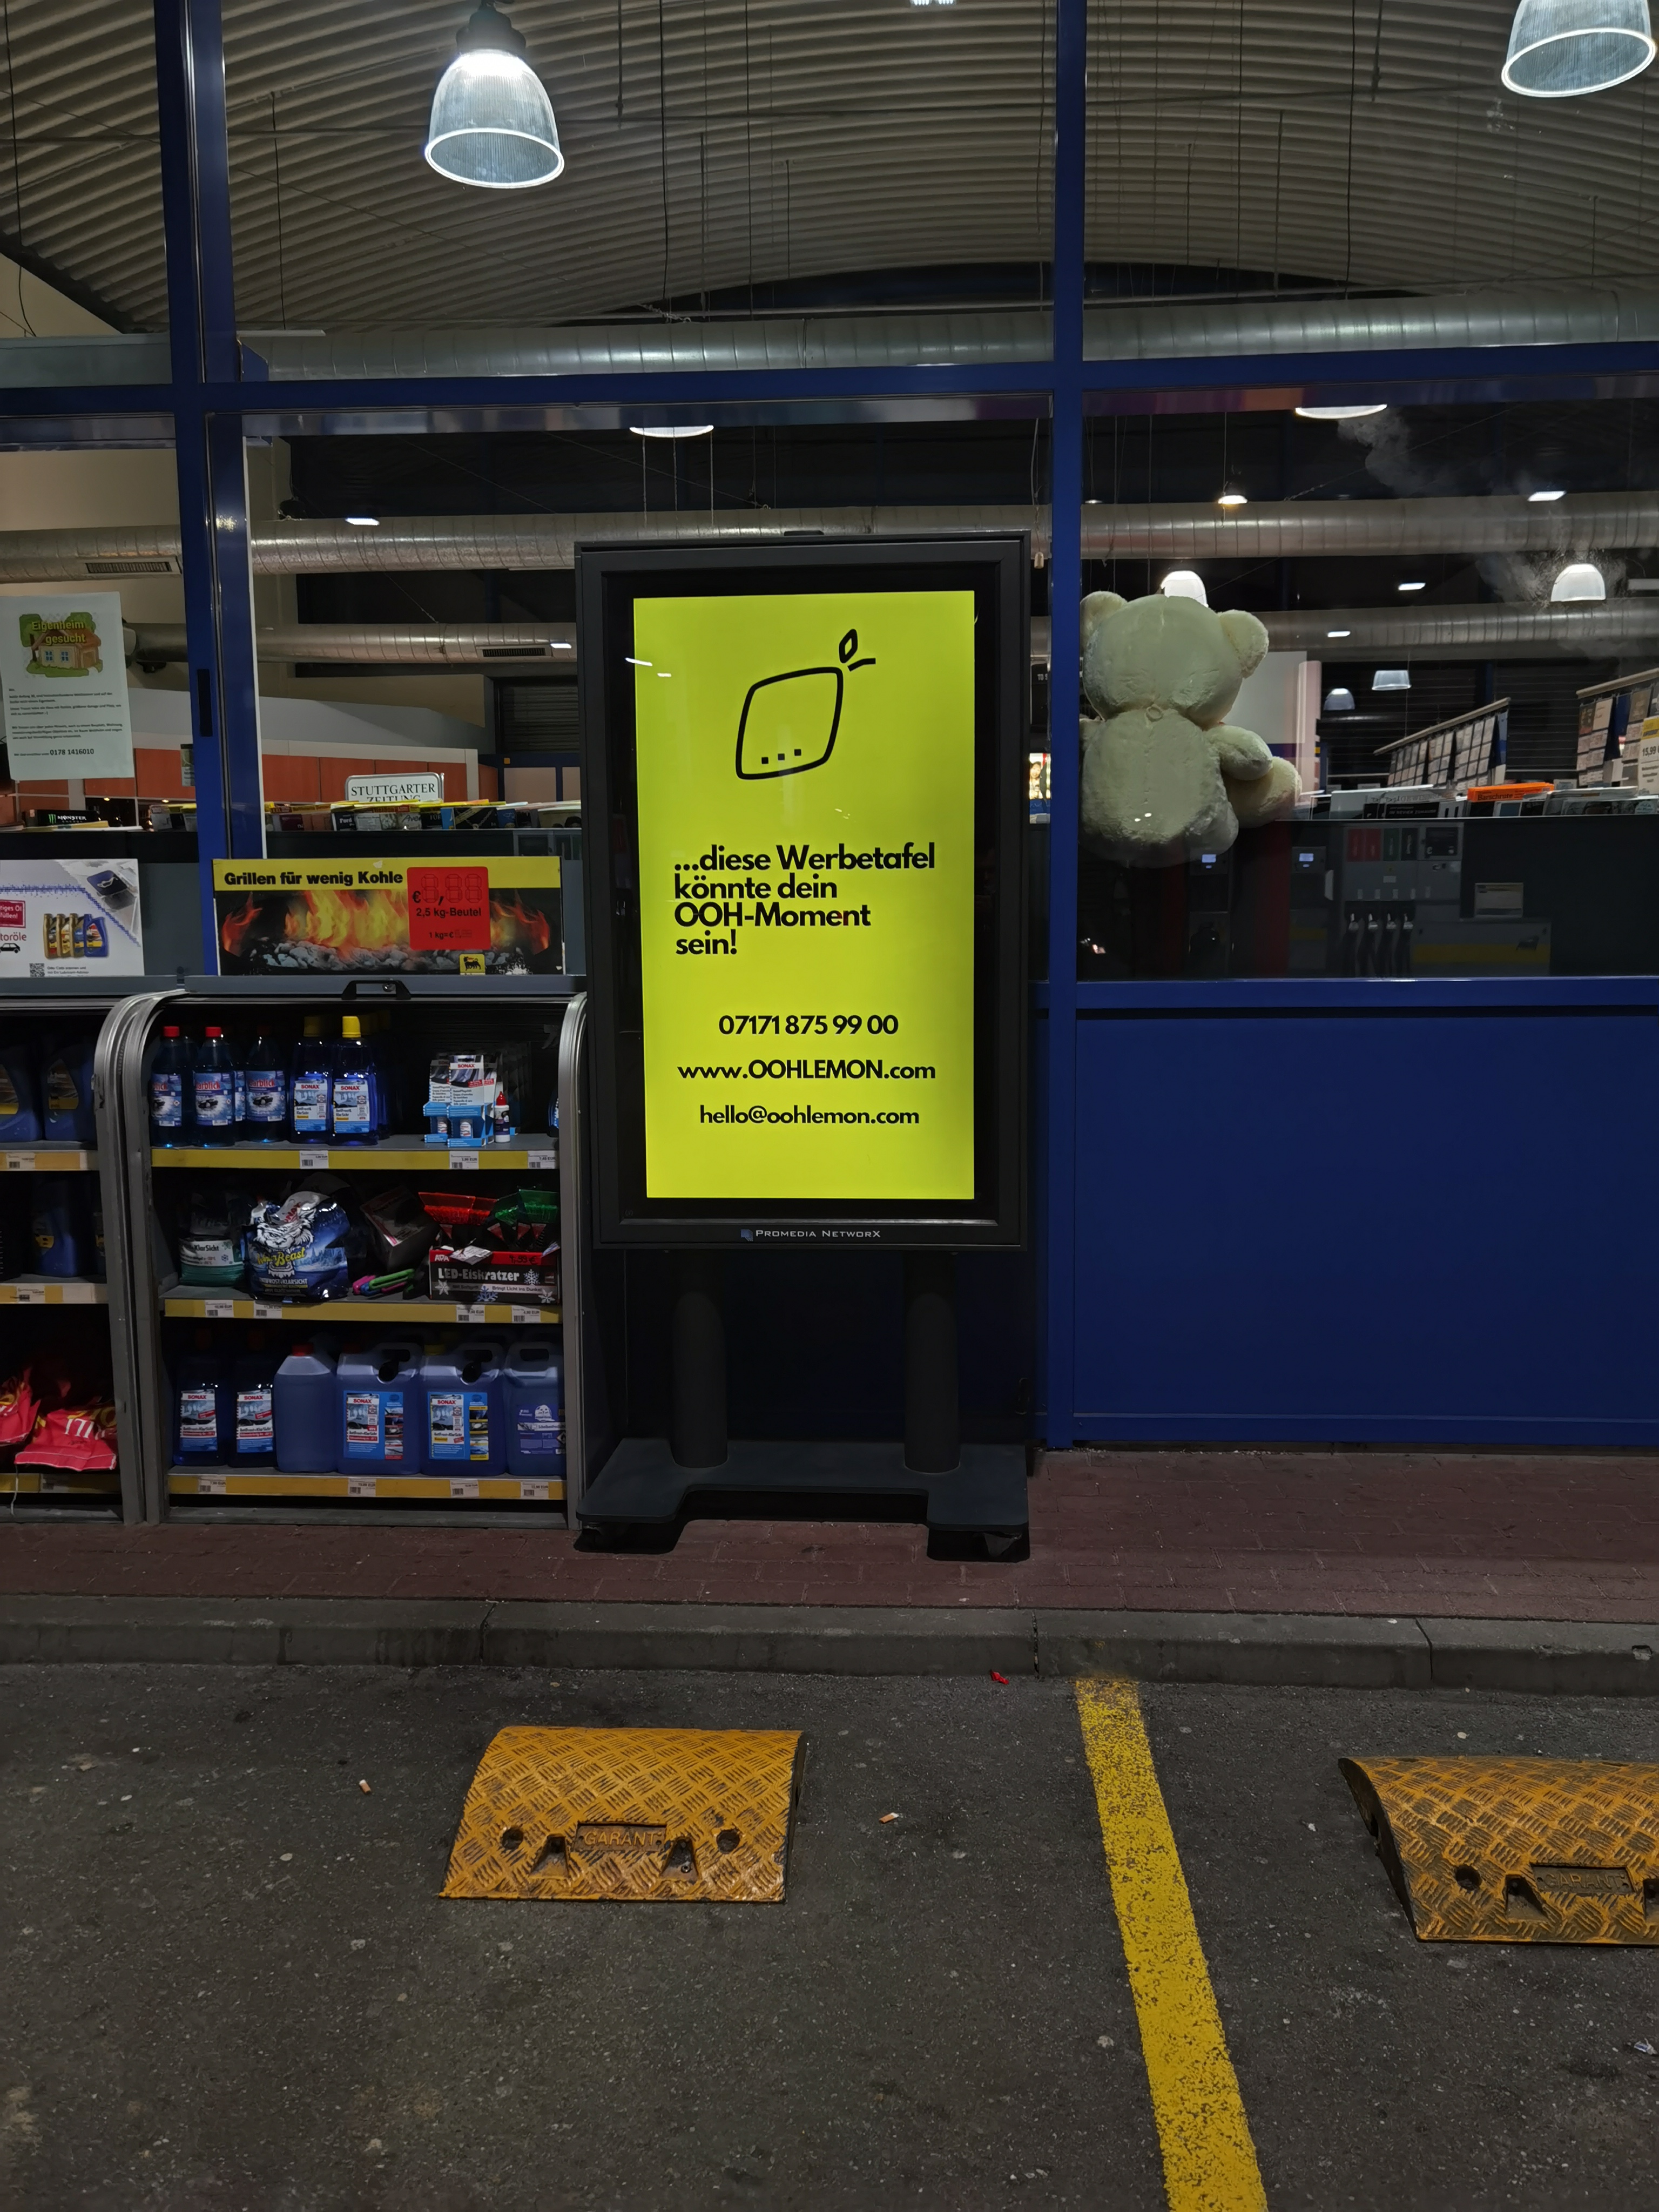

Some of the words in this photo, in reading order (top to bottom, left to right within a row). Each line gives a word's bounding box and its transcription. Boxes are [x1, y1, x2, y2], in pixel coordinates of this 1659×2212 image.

[31, 621, 85, 632] Eigenheim
[45, 633, 87, 646] gesucht
[351, 783, 436, 797] STUTTGARTER
[776, 841, 935, 870] Werbetafel
[224, 871, 276, 885] Grillen
[280, 871, 302, 885] für
[306, 871, 353, 887] wenig
[358, 870, 403, 884] Kohle
[675, 873, 771, 899] könnte
[778, 873, 837, 899] dein
[416, 908, 430, 918] 2,5
[434, 907, 481, 919] kg-Beutel
[674, 901, 871, 927] OOH-Moment
[676, 929, 737, 955] sein!
[719, 1015, 779, 1035] 07171
[785, 1015, 828, 1035] 875
[833, 1015, 862, 1034] 99
[867, 1014, 899, 1035] 00
[677, 1059, 936, 1079] www.OOHLEMON.com
[700, 1104, 919, 1124] hello@oohlemon.com
[275, 1246, 306, 1267] Beast
[437, 1267, 520, 1282] LED-Eiskratzer
[584, 1831, 659, 1846] GARANT
